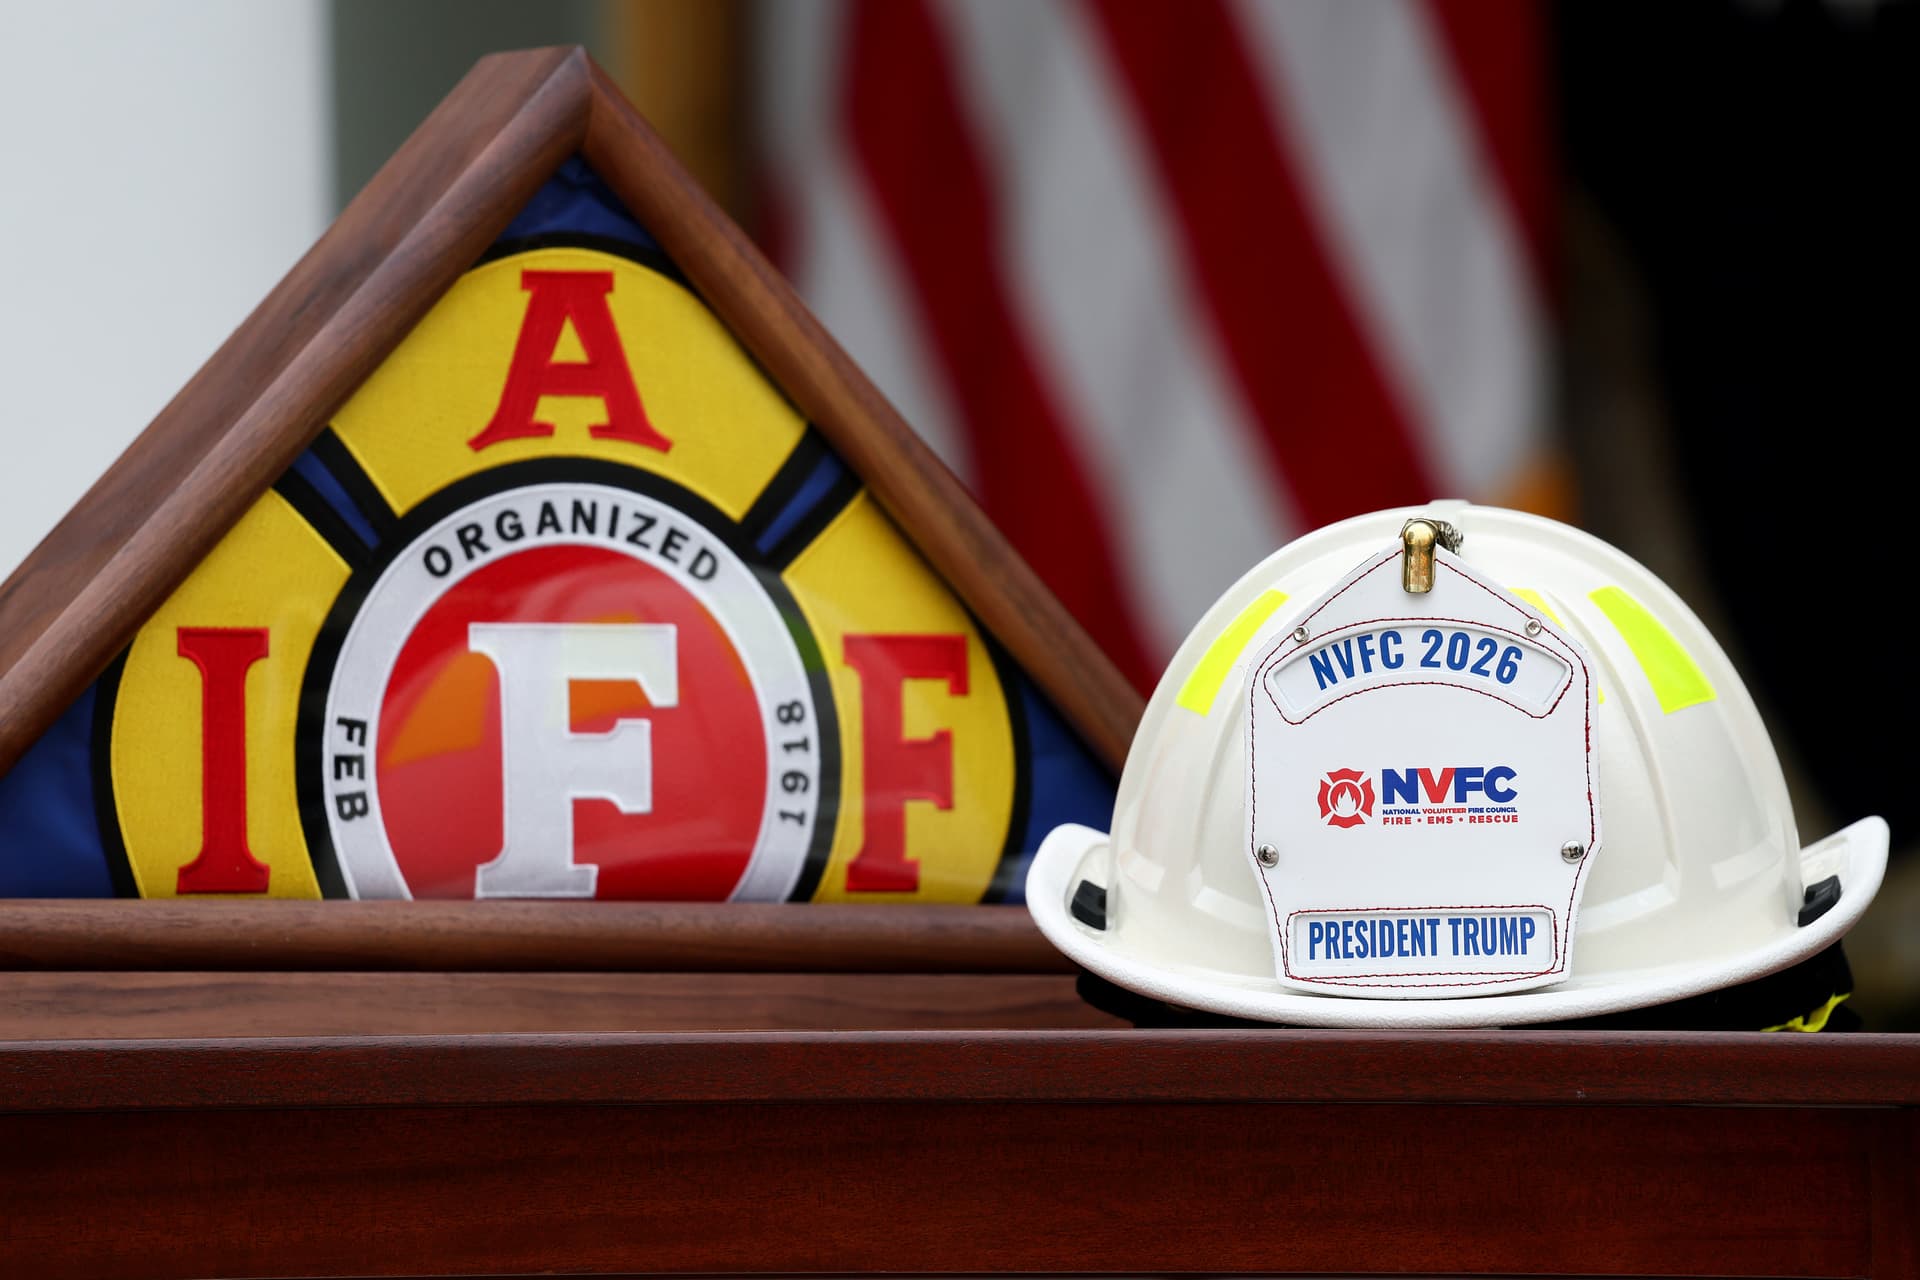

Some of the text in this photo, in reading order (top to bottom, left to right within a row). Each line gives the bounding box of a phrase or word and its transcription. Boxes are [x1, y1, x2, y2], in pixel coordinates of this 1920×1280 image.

[468, 270, 673, 453] A
[422, 498, 719, 582] ORGANIZED
[1309, 629, 1523, 690] NVFC 2026
[177, 627, 269, 894] I
[334, 716, 370, 822] FEB
[469, 623, 678, 898] F
[778, 699, 809, 826] 1918
[843, 634, 969, 893] F
[1382, 766, 1518, 804] NVFC
[1383, 815, 1519, 825] FIRE EMS RESCUE
[1309, 917, 1536, 960] PRESIDENT TRUMP
